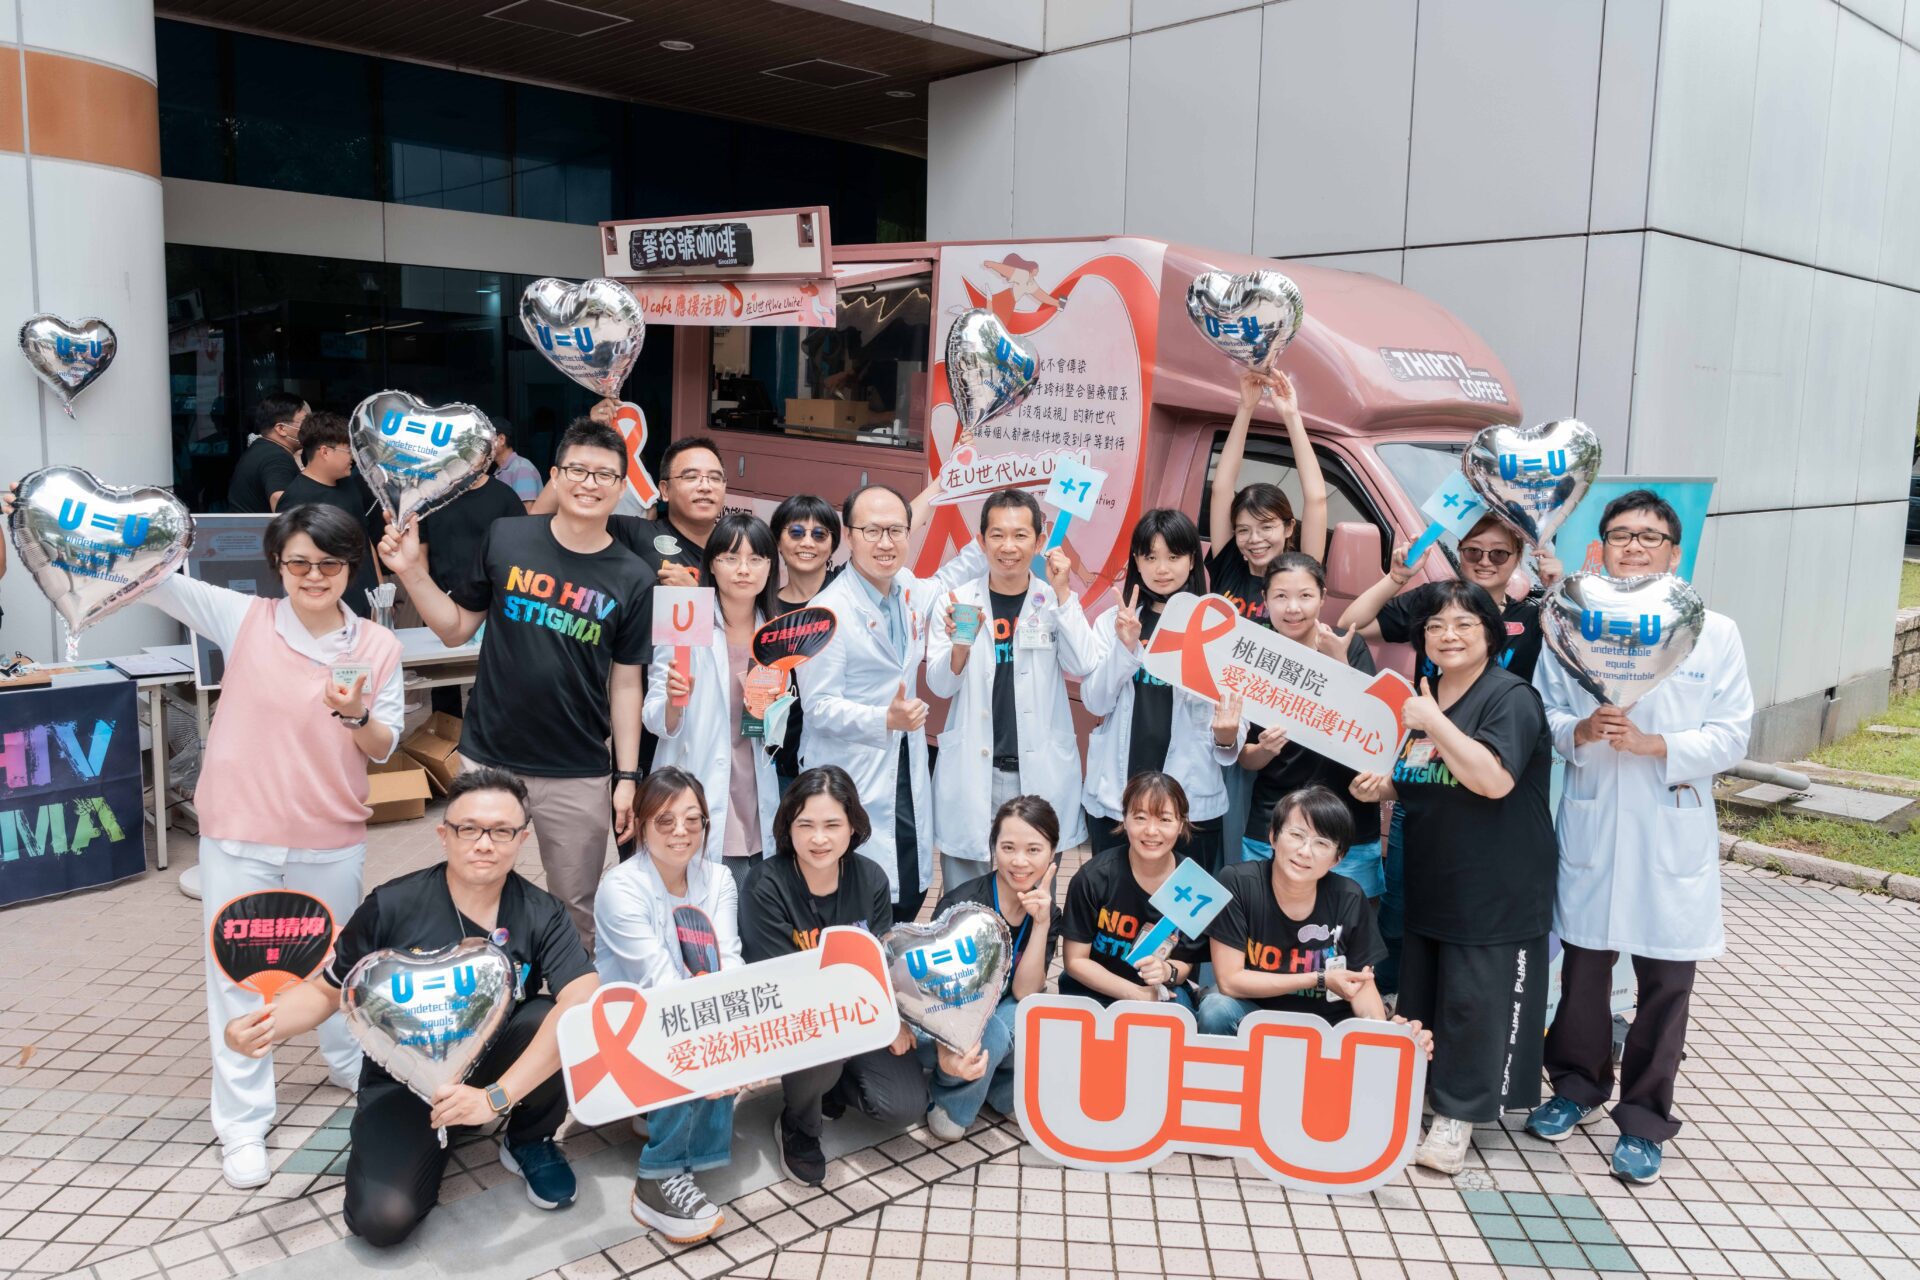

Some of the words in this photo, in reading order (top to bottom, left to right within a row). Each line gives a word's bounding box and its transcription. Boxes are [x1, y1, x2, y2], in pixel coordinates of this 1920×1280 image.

[651, 295, 672, 317] café
[675, 293, 727, 317] 應援活動
[56, 336, 102, 358] U=U
[536, 322, 594, 353] U=U
[1390, 351, 1471, 379] THIRTY
[1459, 378, 1508, 402] COFFEE
[381, 409, 454, 447] U=U
[386, 438, 439, 457] undetectable
[1499, 449, 1567, 481] U=U
[57, 498, 149, 547] U=U
[504, 565, 556, 598] NO
[559, 581, 618, 621] HIV
[503, 595, 602, 646] STIGMA
[672, 600, 695, 631] U
[1580, 610, 1662, 646] U=U
[1231, 635, 1329, 698] 桃園醫院
[1591, 645, 1651, 657] undetectable
[1605, 660, 1636, 669] equals
[1217, 662, 1384, 756] 愛滋病照護中心
[223, 917, 325, 940] 打起精神
[1097, 908, 1139, 939] NO
[905, 935, 978, 980] U=U
[1247, 936, 1282, 971] NO
[391, 965, 477, 1004] U=U
[421, 1016, 454, 1029] equals
[658, 982, 784, 1039] 桃園醫院
[666, 995, 880, 1077] 愛滋病照護中心
[1037, 1017, 1402, 1174] U=U
